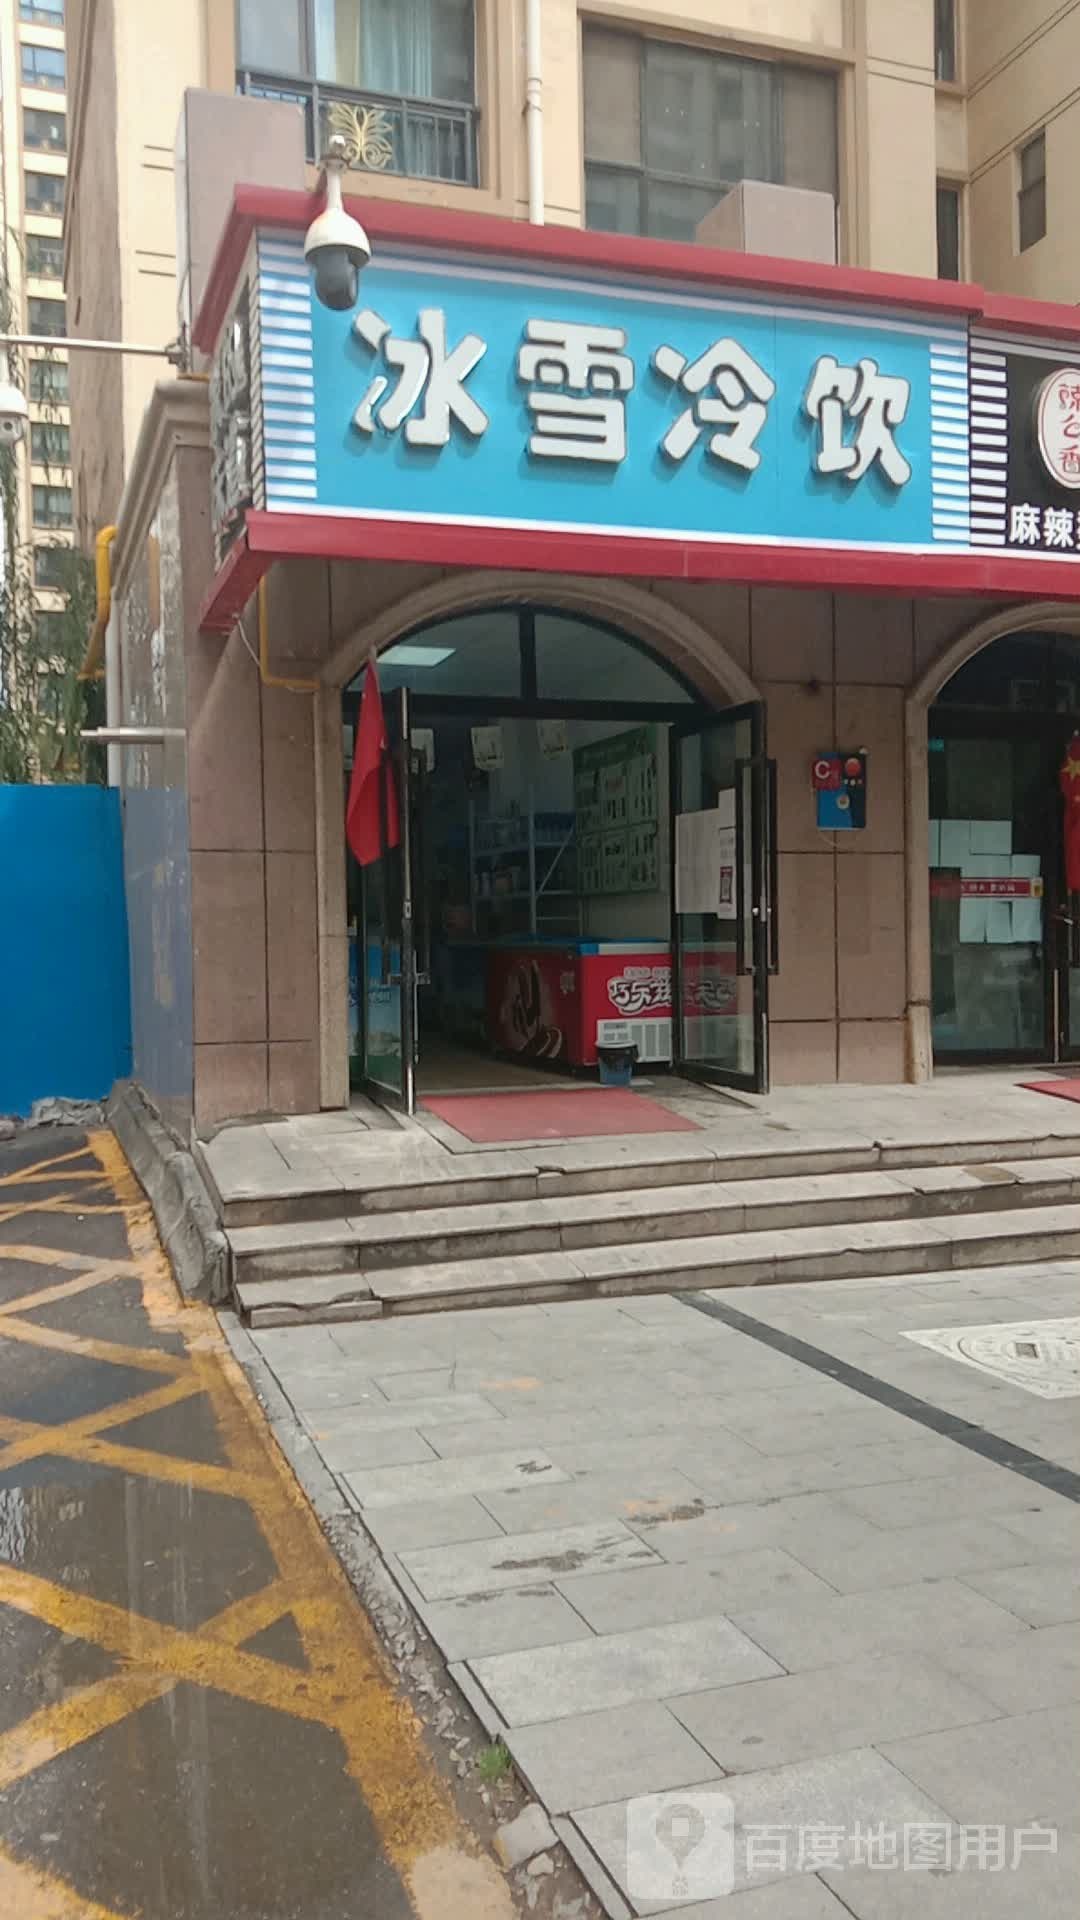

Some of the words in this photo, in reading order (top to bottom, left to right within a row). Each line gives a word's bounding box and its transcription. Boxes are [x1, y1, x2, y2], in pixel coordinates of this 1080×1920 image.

[351, 307, 912, 487] 冰雪冷饮
[1009, 502, 1080, 550] 麻辣
